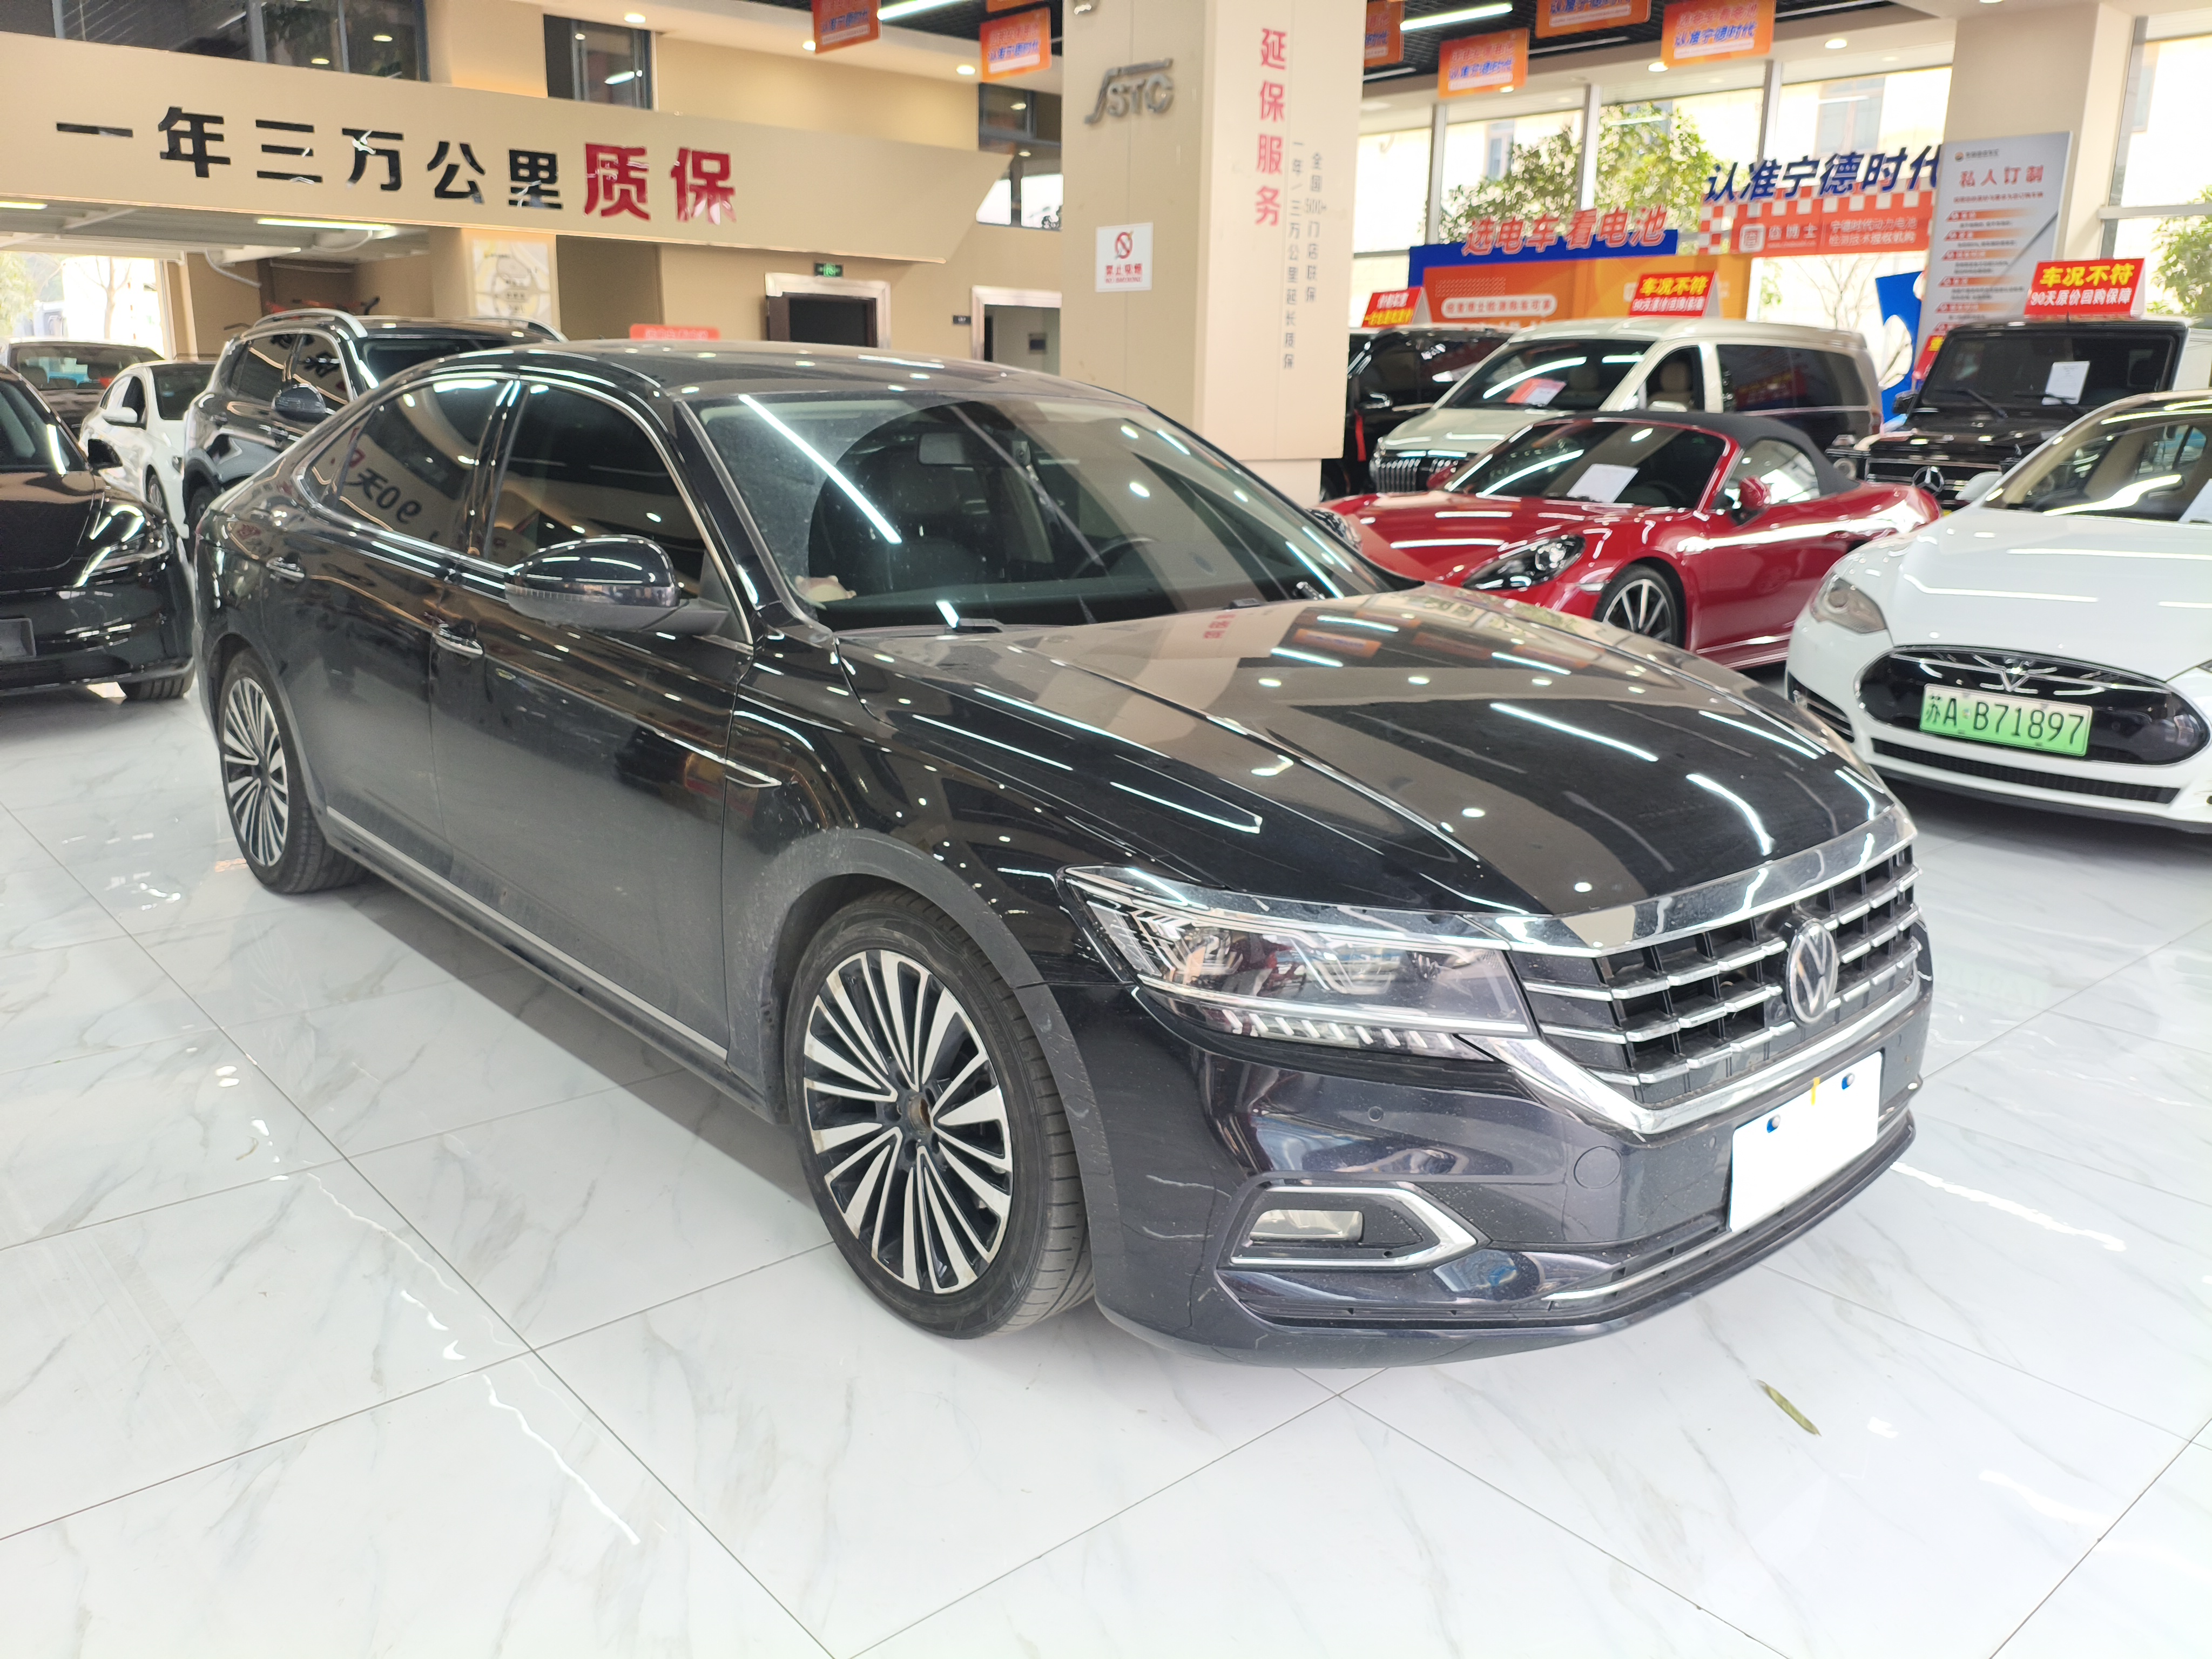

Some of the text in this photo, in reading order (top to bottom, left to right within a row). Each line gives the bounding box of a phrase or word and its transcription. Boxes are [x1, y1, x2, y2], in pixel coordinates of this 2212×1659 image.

[1255, 28, 1287, 226] 延保服务
[56, 106, 737, 225] 一年三万公里质保
[1705, 145, 1941, 201] 认准宁德时代
[1960, 164, 2044, 188] 私人订制
[1461, 204, 1668, 257] 选电车看电池
[1830, 218, 1917, 233] 宁德时代动力电池
[1640, 275, 1709, 296] 车况不符
[2040, 262, 2135, 288] 车况不符
[2030, 287, 2133, 307] 90天原价回购保障
